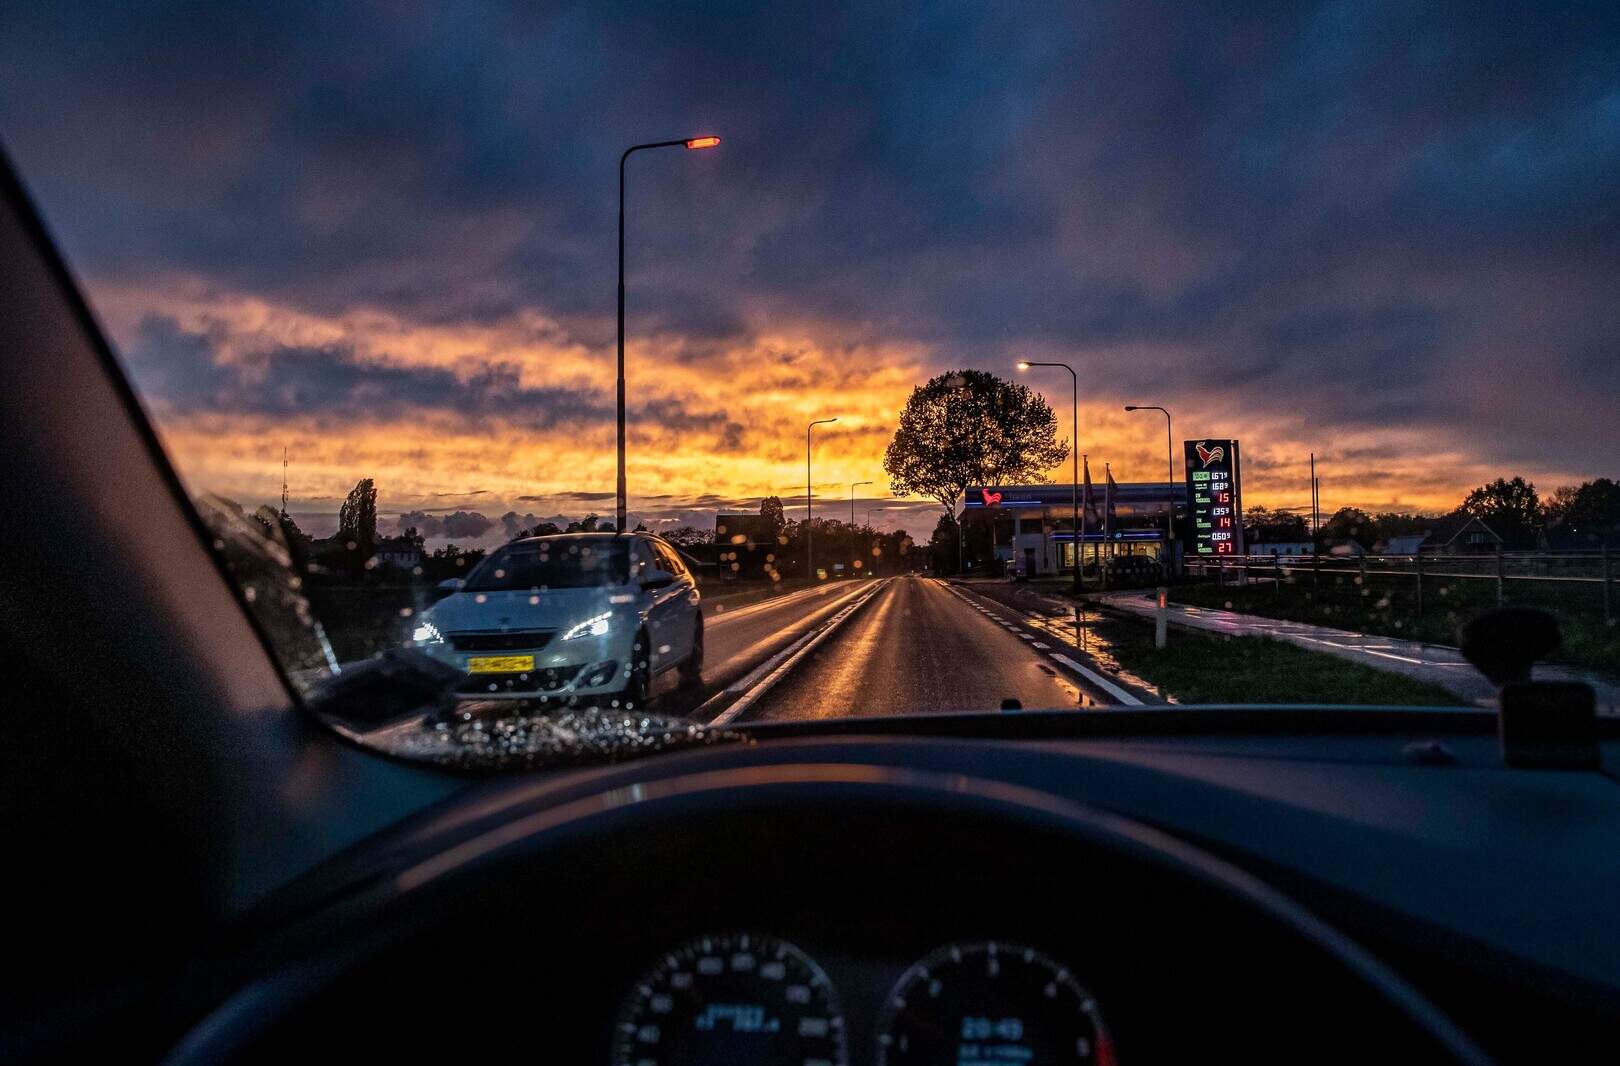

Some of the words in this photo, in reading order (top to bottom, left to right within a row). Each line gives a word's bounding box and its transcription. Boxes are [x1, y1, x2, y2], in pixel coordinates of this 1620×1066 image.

[1219, 493, 1229, 502] 15
[1220, 518, 1230, 527] 14
[1218, 543, 1232, 552] 27
